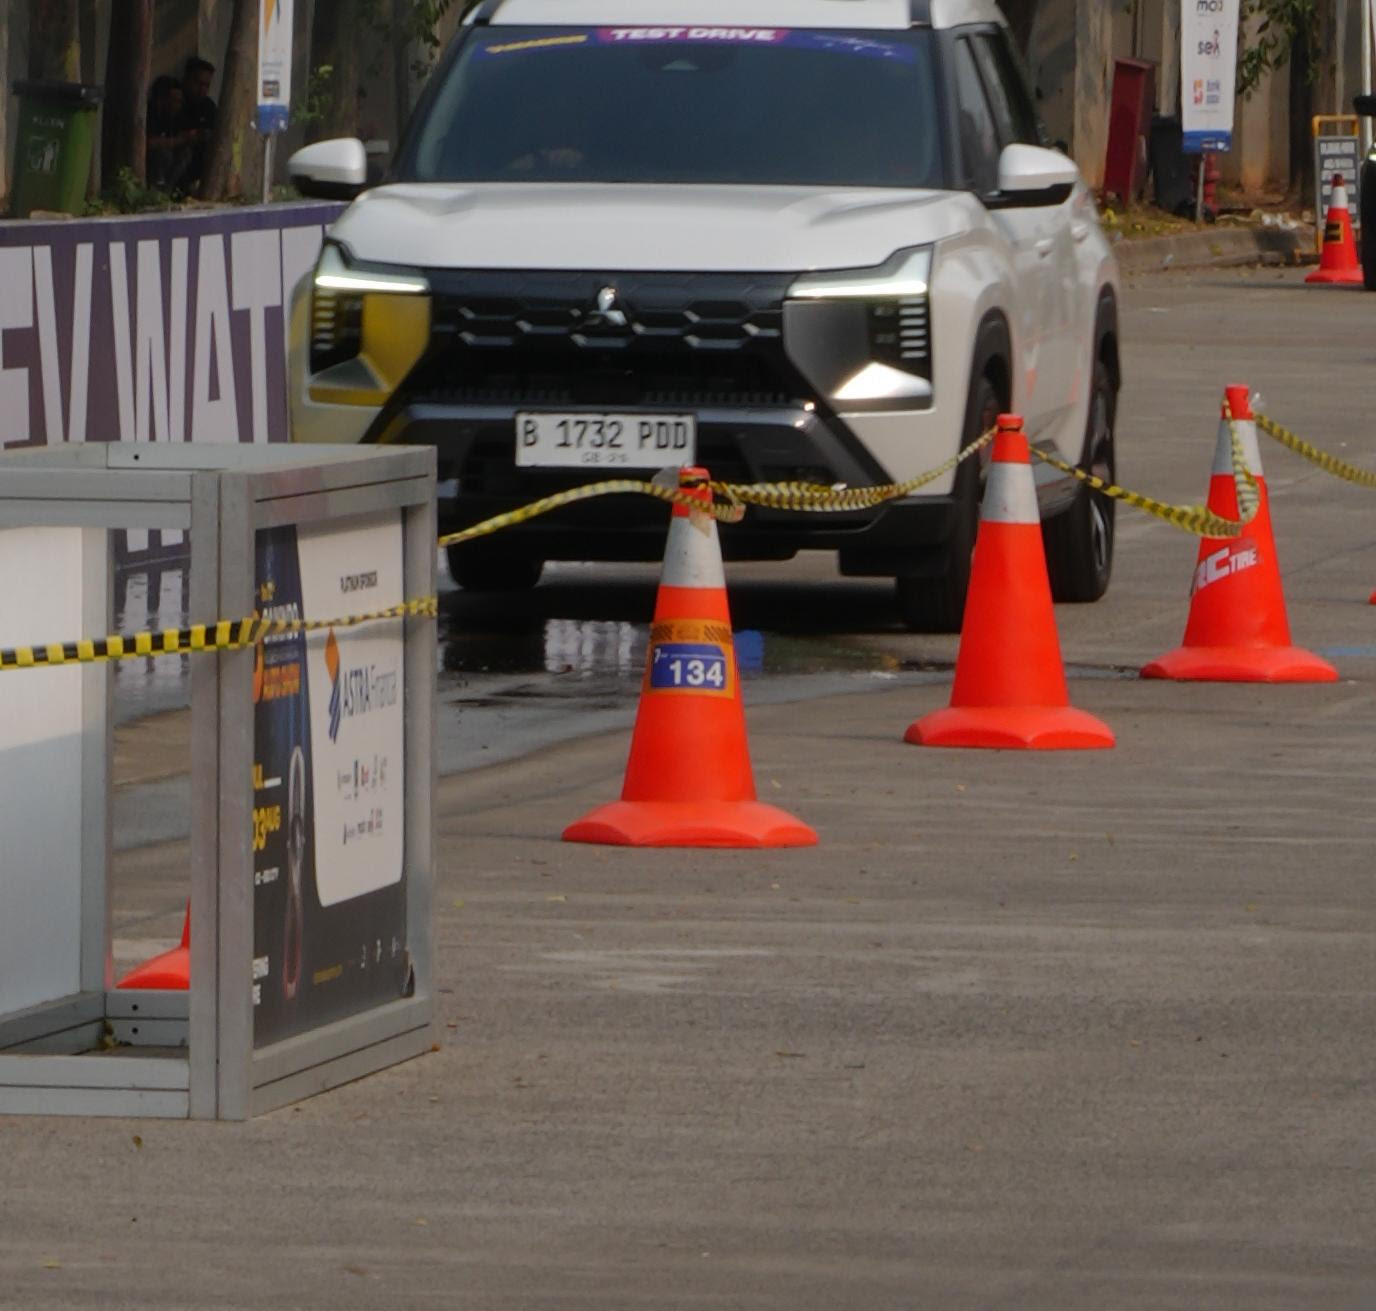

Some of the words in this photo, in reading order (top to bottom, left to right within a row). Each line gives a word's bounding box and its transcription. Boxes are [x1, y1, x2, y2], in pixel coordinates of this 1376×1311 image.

[612, 27, 681, 40] TEST
[687, 28, 776, 41] DRIVE
[522, 419, 539, 447] B
[554, 419, 624, 449] 1732
[638, 421, 688, 450] PDD
[669, 659, 724, 687] 134
